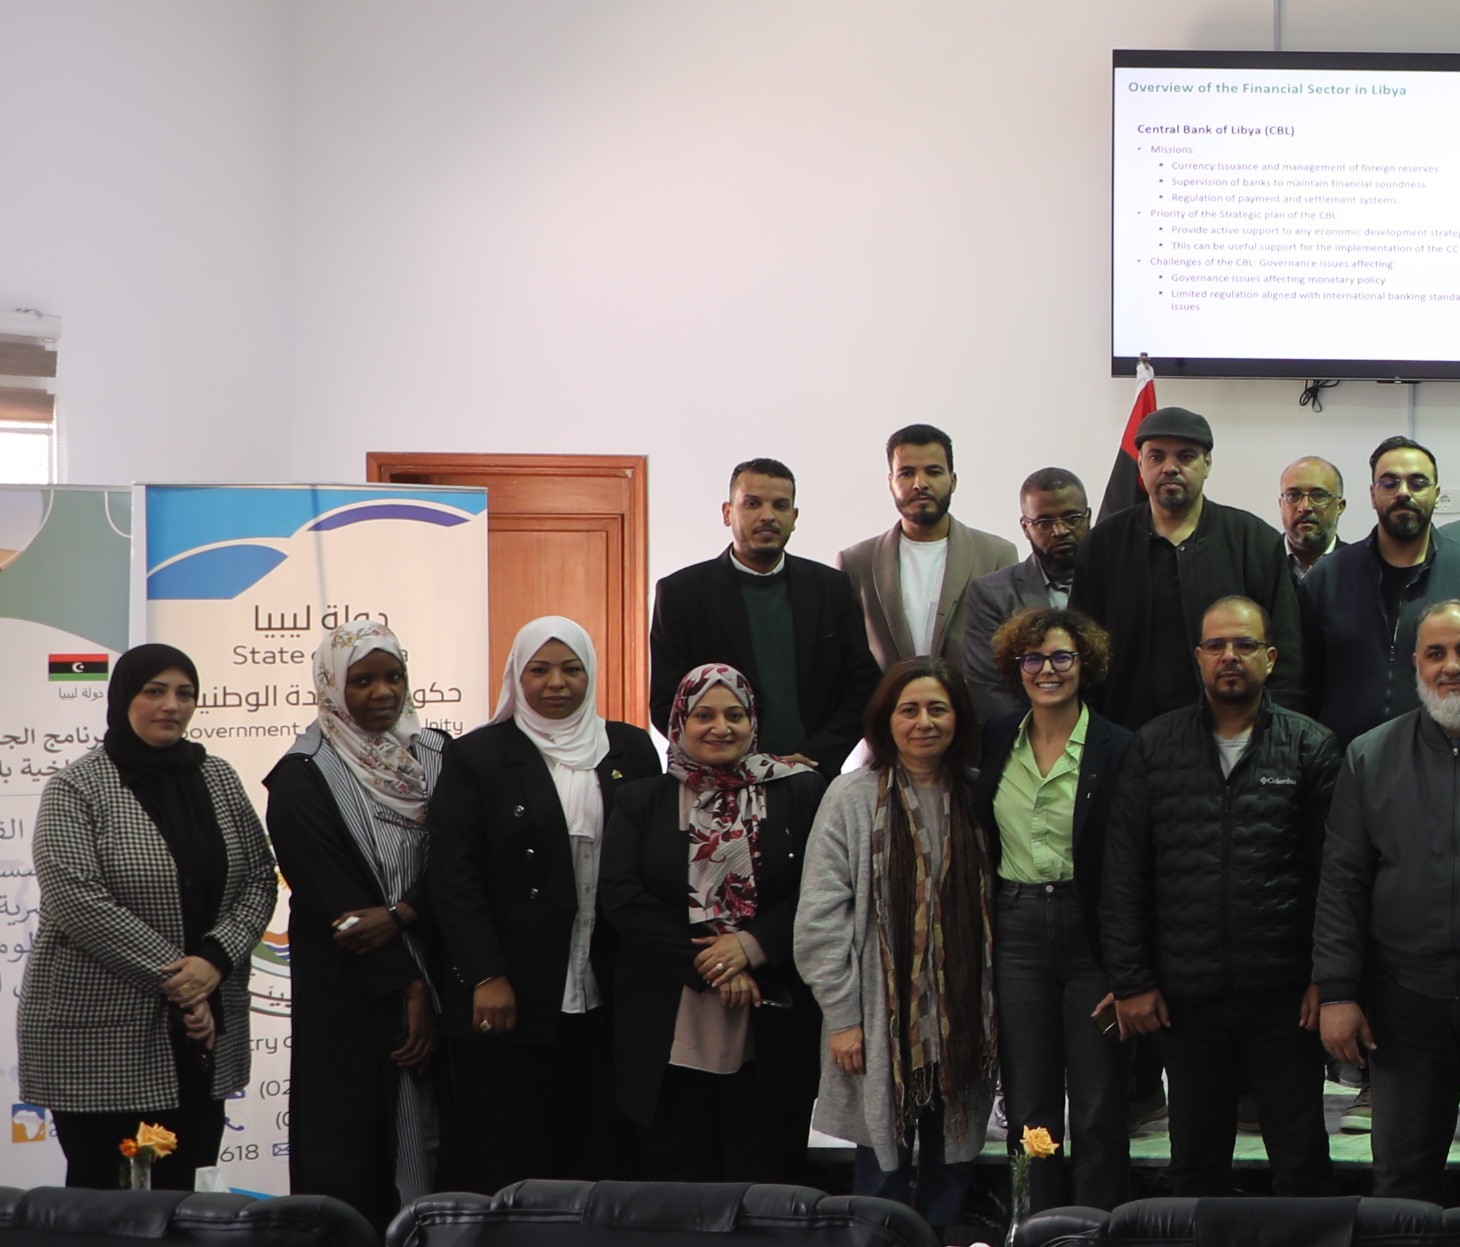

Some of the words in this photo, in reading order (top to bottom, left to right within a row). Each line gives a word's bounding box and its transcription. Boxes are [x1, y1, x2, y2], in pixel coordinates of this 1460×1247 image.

[1127, 81, 1193, 92] Overview
[1197, 81, 1212, 92] of
[1215, 82, 1238, 93] the
[1242, 82, 1303, 93] Financial
[1307, 84, 1350, 94] Sector
[1354, 84, 1367, 94] in
[1371, 84, 1406, 97] Libya
[1137, 124, 1179, 134] Central
[1182, 124, 1212, 134] Bank
[1215, 124, 1227, 134] of
[1231, 125, 1261, 136] Libya
[1264, 125, 1294, 137] (CBL)
[1170, 289, 1207, 298] Limited
[1209, 289, 1258, 300] regulation
[1261, 290, 1296, 301] aligned
[1298, 290, 1320, 299] with
[1322, 291, 1386, 300] international
[1387, 292, 1426, 302] banking
[254, 604, 311, 639] ليبيا
[232, 645, 306, 665] State
